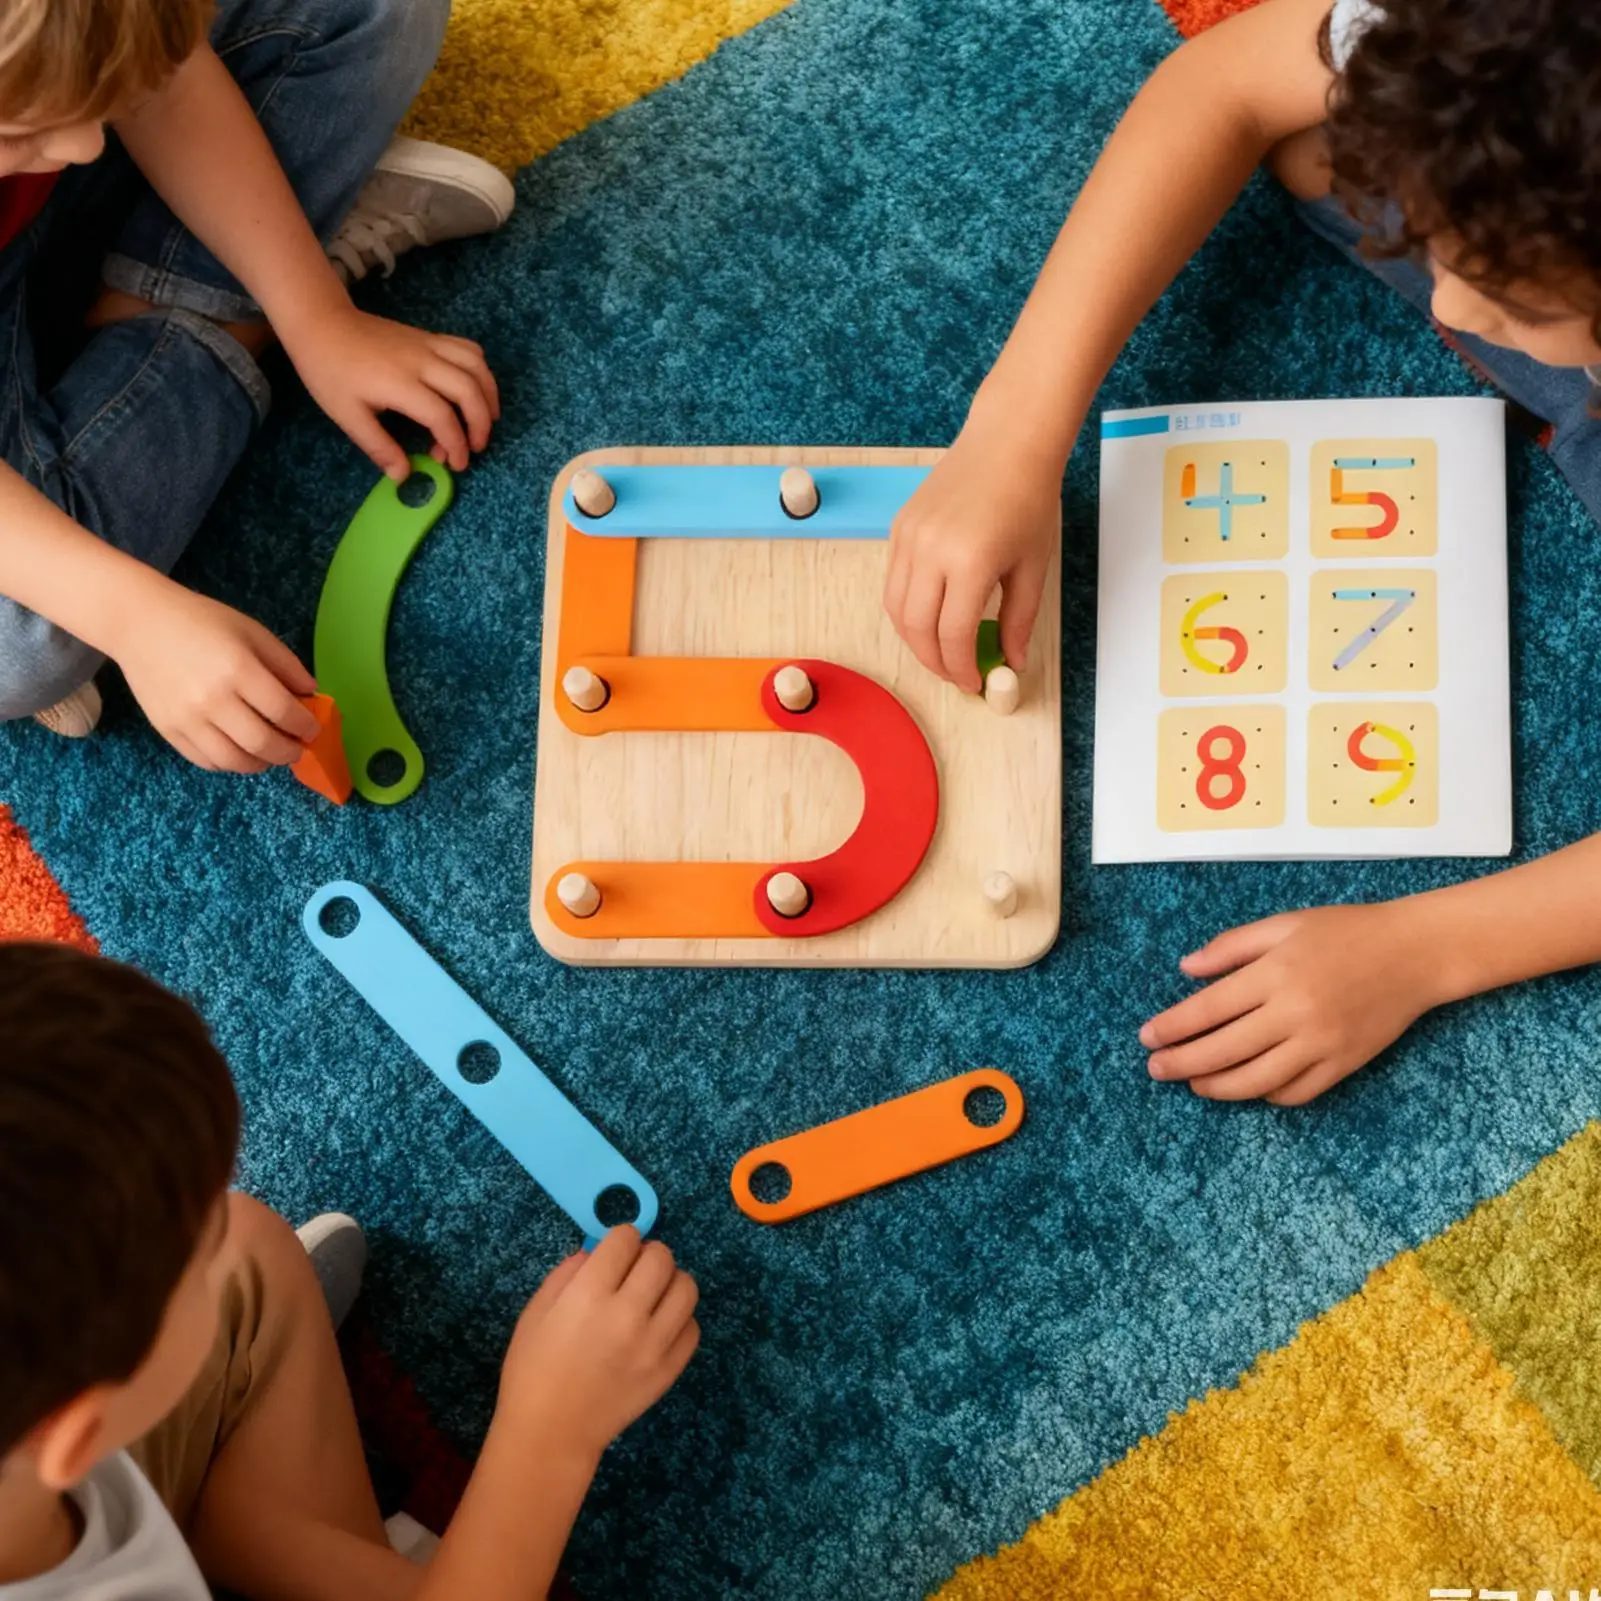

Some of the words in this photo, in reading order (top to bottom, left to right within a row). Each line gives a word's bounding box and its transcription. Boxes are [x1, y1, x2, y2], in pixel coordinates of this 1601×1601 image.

[1181, 463, 1268, 541] 4
[1330, 457, 1416, 540] 5
[1181, 591, 1249, 674] 6
[1331, 588, 1417, 671] 7
[1196, 725, 1247, 810] 8
[1346, 721, 1417, 806] 9
